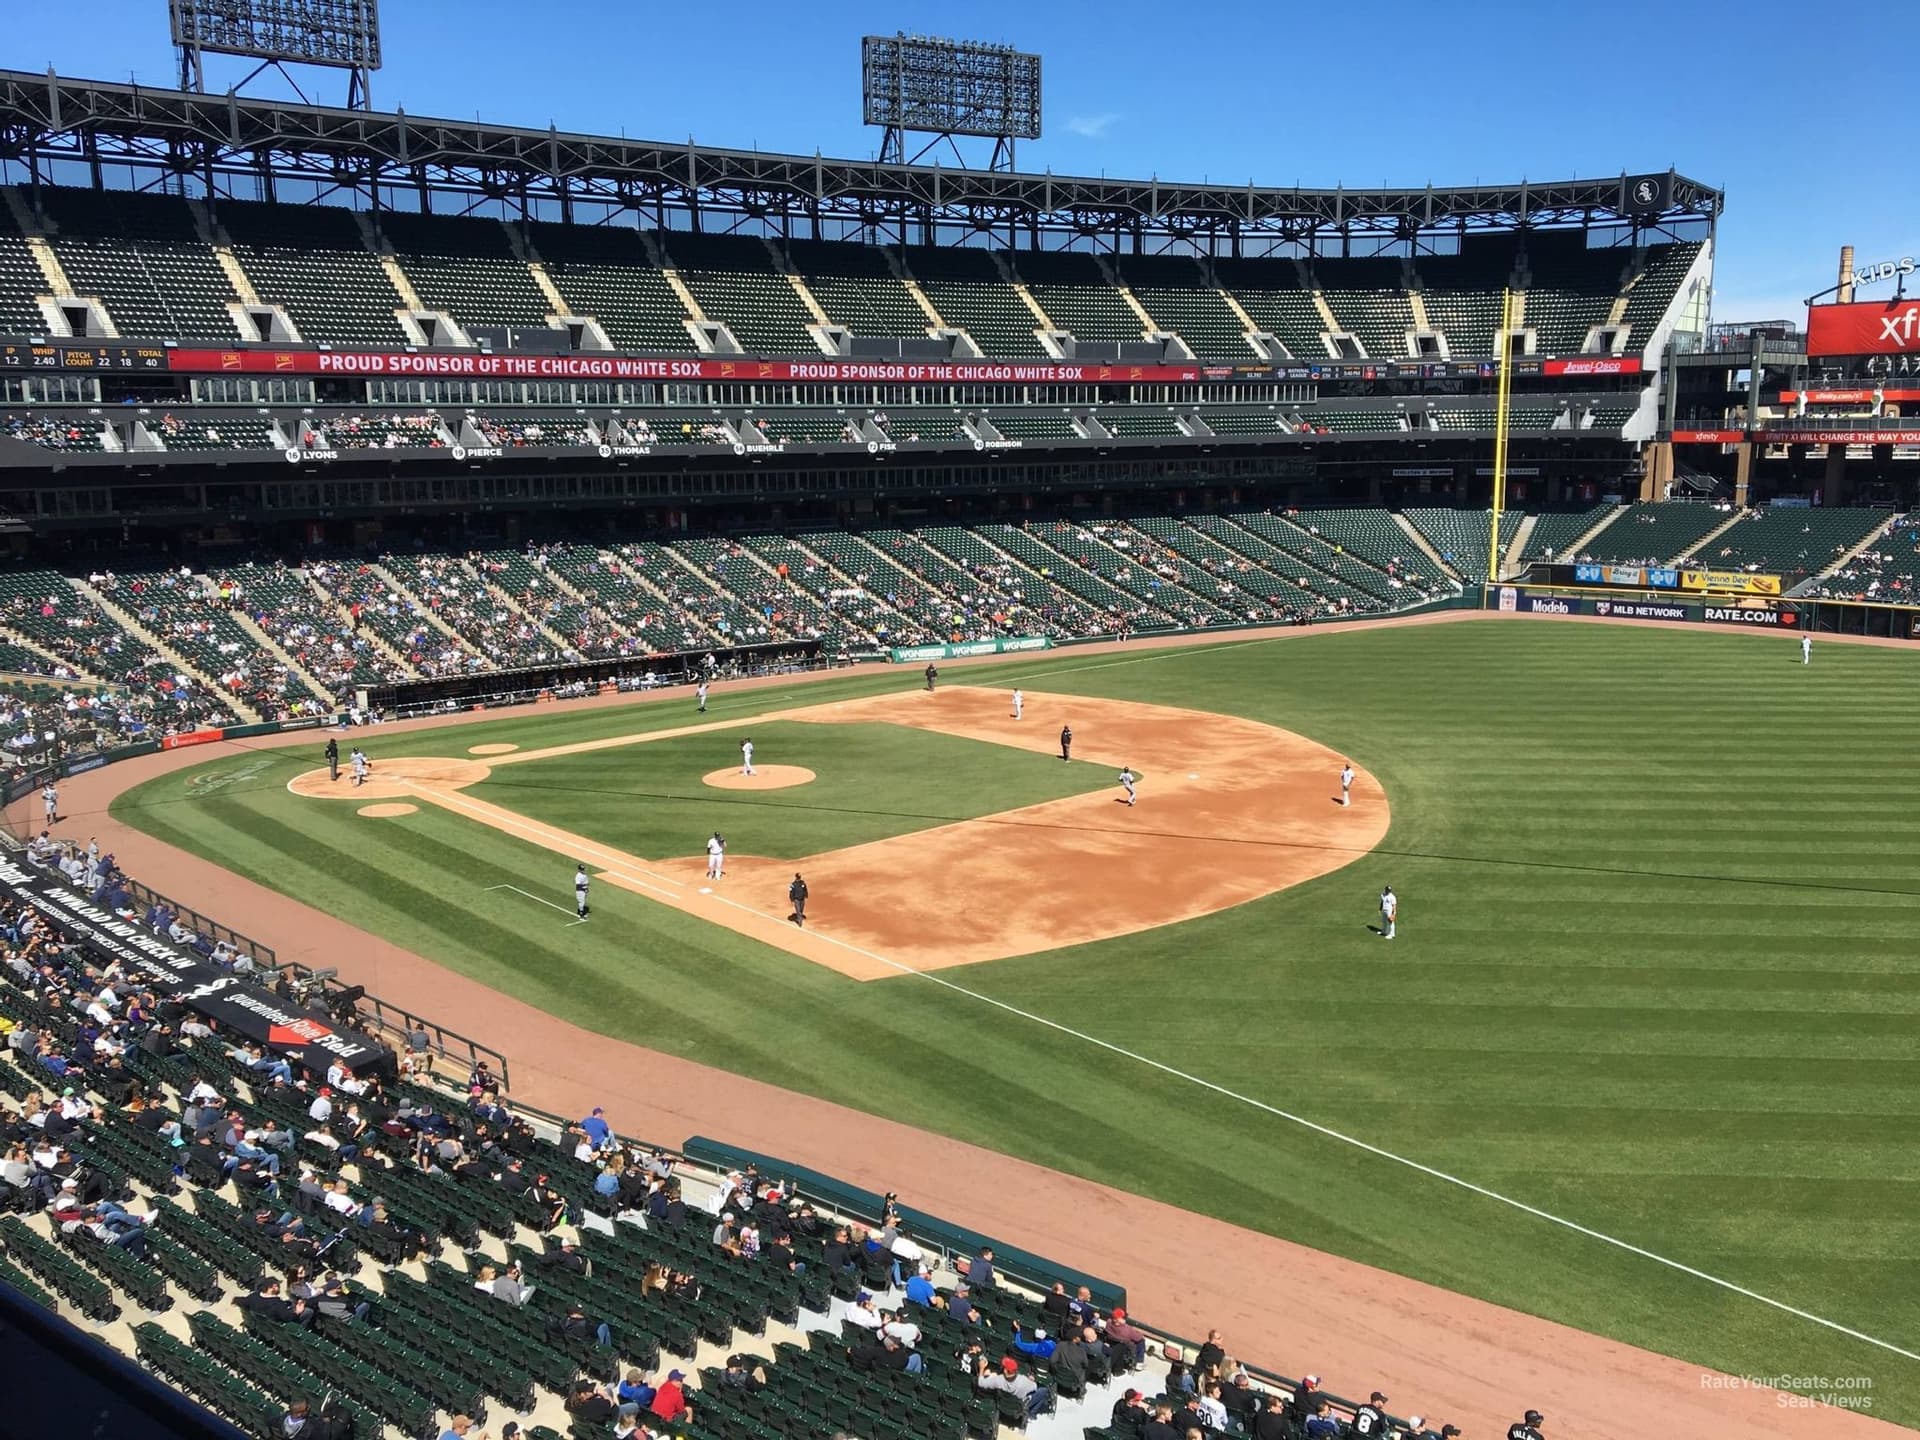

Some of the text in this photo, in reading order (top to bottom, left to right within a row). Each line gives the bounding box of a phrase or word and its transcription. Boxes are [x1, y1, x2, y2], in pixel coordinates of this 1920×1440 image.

[1850, 256, 1917, 289] KIDS
[32, 347, 55, 355] WHIP
[67, 351, 90, 359] PITCH
[4, 356, 19, 365] 1.2
[34, 357, 55, 365] 2.40
[65, 359, 94, 367] COUNT
[99, 358, 110, 366] 22
[121, 358, 132, 366] 18
[145, 358, 157, 367] 40
[319, 355, 702, 377] PROUD SPONSOR OF THE CHICAGO WHITE SOX
[1567, 361, 1621, 371] Jewel-Osco
[789, 363, 1083, 380] PROUD SPONSOR OF THE CHICAGO WHITE SOX
[1695, 432, 1719, 442] xfinity
[1800, 432, 1818, 441] WILL
[1819, 432, 1856, 441] CHANGE
[1858, 432, 1876, 441] THE
[1877, 432, 1899, 441] WAY
[746, 444, 785, 453] BUEHRLE
[879, 443, 897, 451] FISK
[985, 440, 1023, 449] ROBINSON
[303, 450, 338, 460] LYONS
[467, 448, 503, 457] PIERCE
[613, 447, 651, 455] THOMAS
[1702, 573, 1751, 584] Vienna Beef
[1532, 599, 1568, 614] Modelo
[1613, 606, 1684, 618] MLB NETWORK
[1705, 608, 1778, 624] RATE.COM
[899, 649, 920, 659] WGN
[952, 645, 974, 656] WGN
[42, 887, 113, 923] DOWNLOAD
[99, 921, 137, 937] AND
[30, 898, 76, 923] CONCESSIONS
[118, 949, 144, 962] SEAT
[136, 959, 184, 984] UPGRADES
[224, 993, 367, 1058] guaranteed Rate Field
[1358, 1414, 1371, 1434] 8
